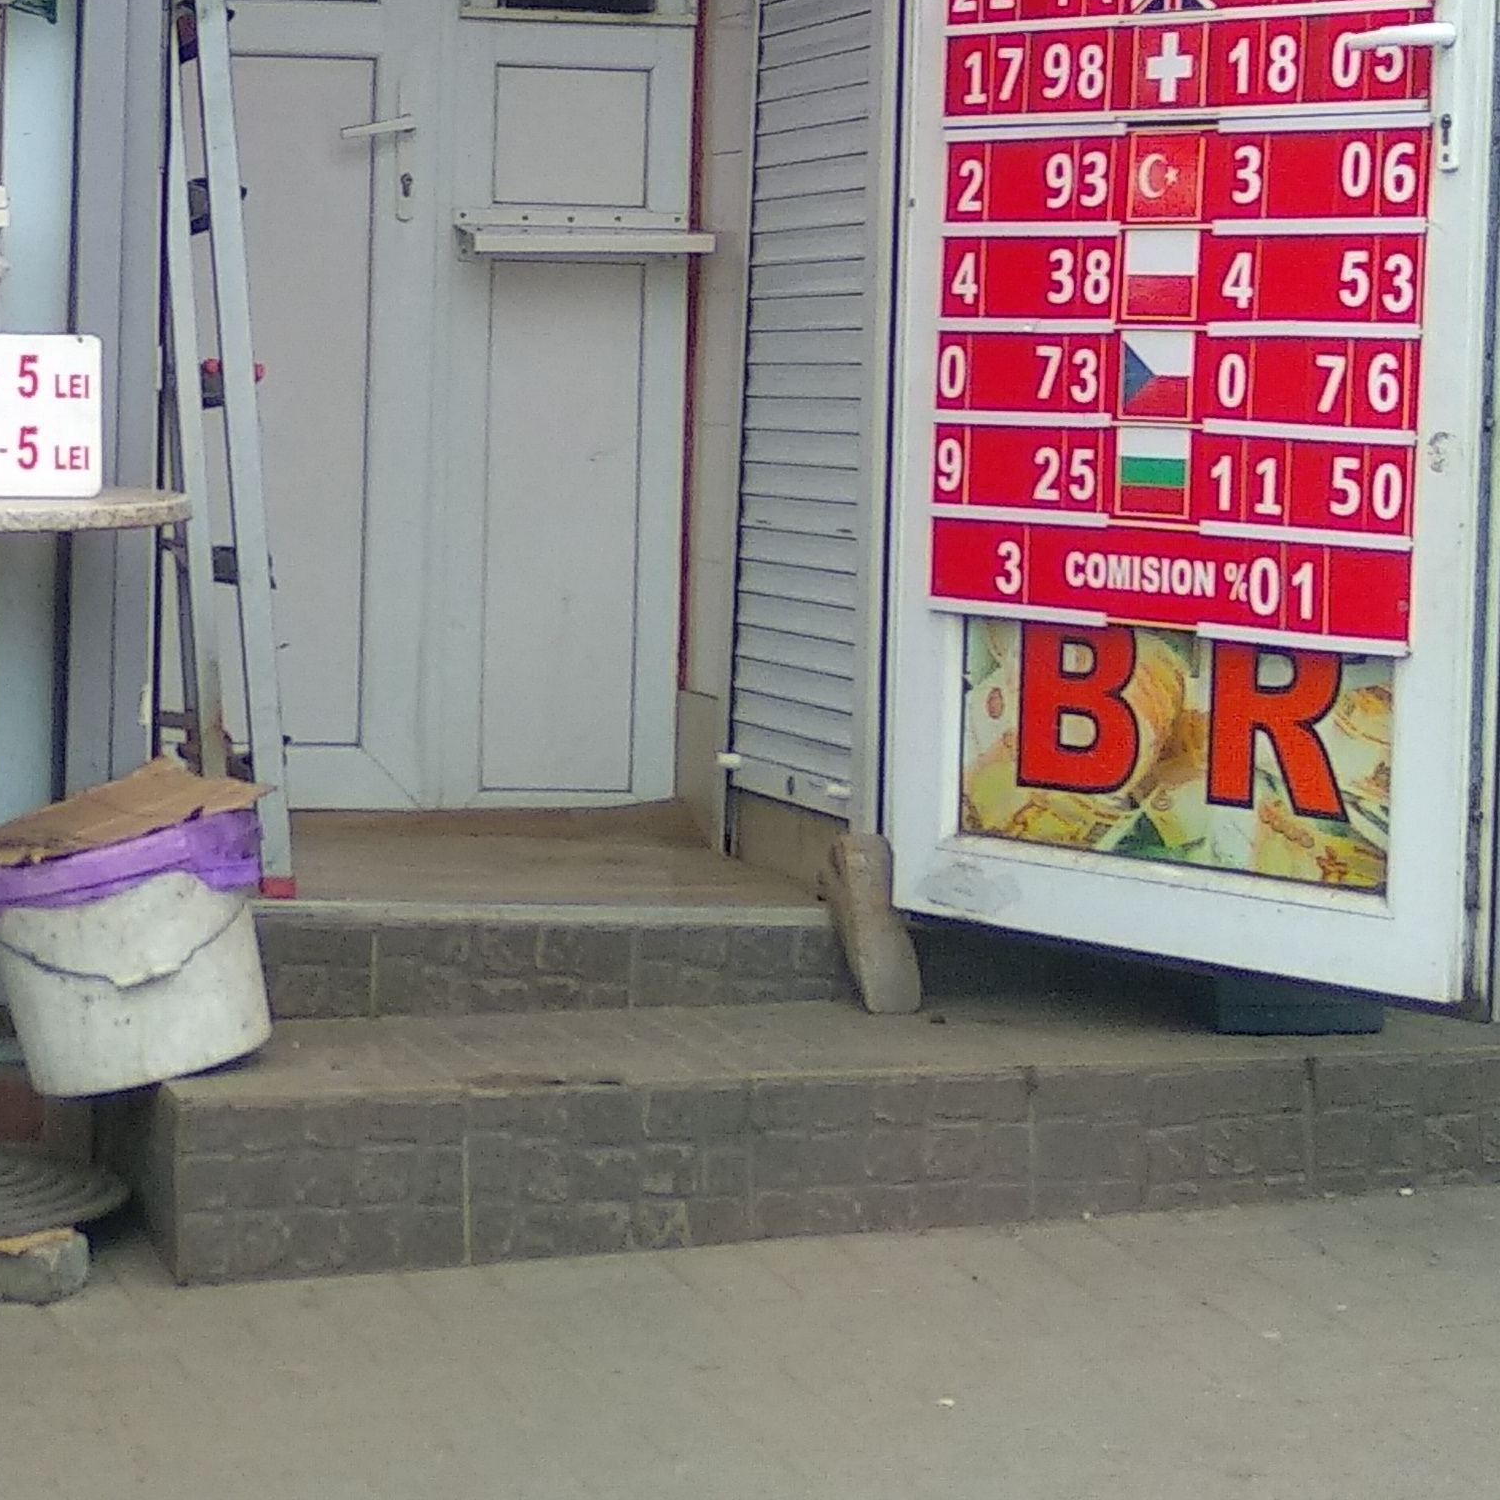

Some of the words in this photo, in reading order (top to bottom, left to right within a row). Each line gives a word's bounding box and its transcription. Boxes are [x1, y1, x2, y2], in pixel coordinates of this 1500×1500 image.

[18, 355, 40, 398] 5
[54, 374, 90, 399] LEI
[54, 446, 90, 471] LEI
[1065, 550, 1215, 598] COMISION
